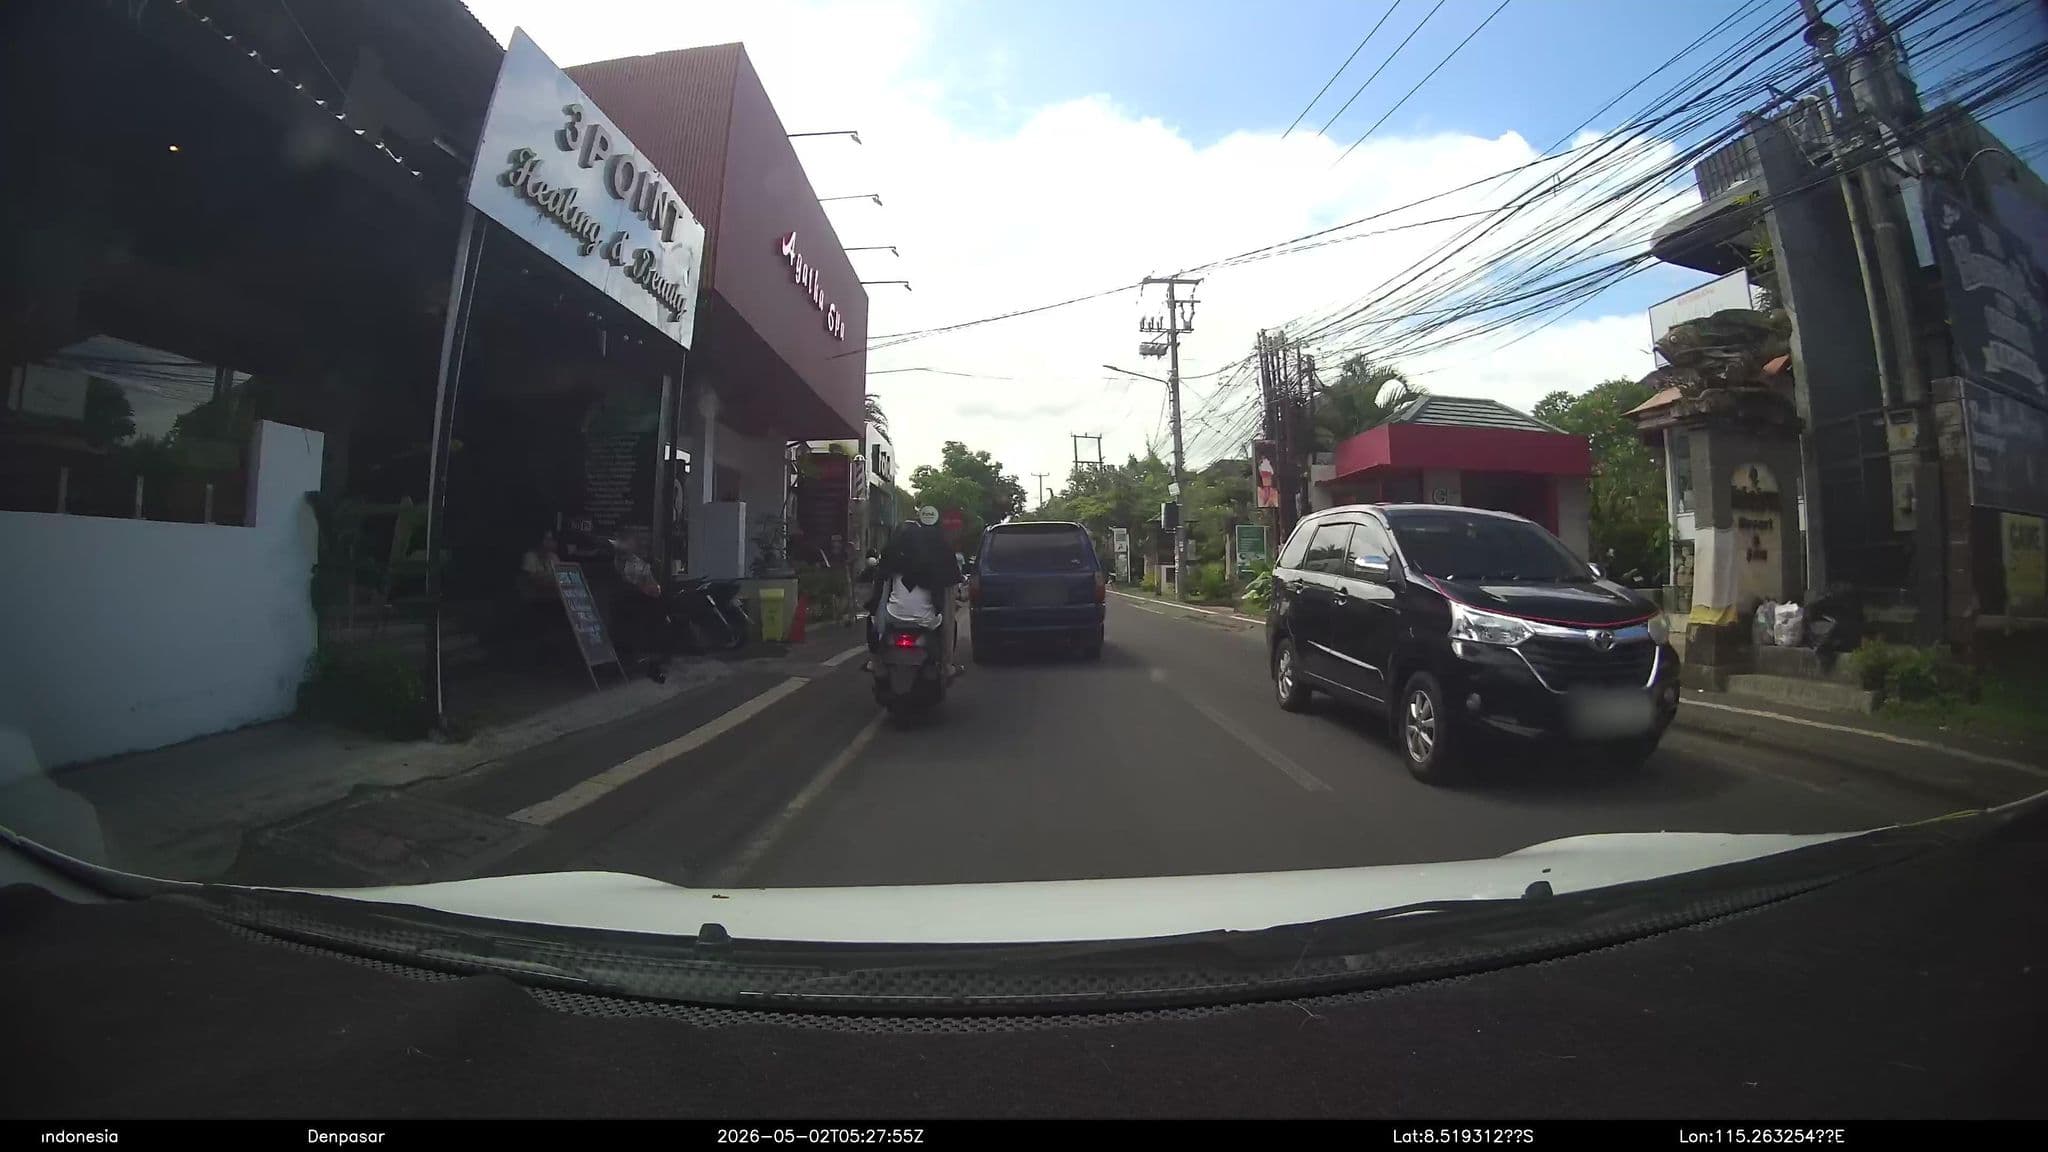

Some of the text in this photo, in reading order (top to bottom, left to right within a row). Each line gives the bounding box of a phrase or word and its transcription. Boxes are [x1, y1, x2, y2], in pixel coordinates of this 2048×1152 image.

[497, 147, 601, 256] Healing
[624, 248, 686, 322] Beauty
[827, 303, 845, 341] Spa
